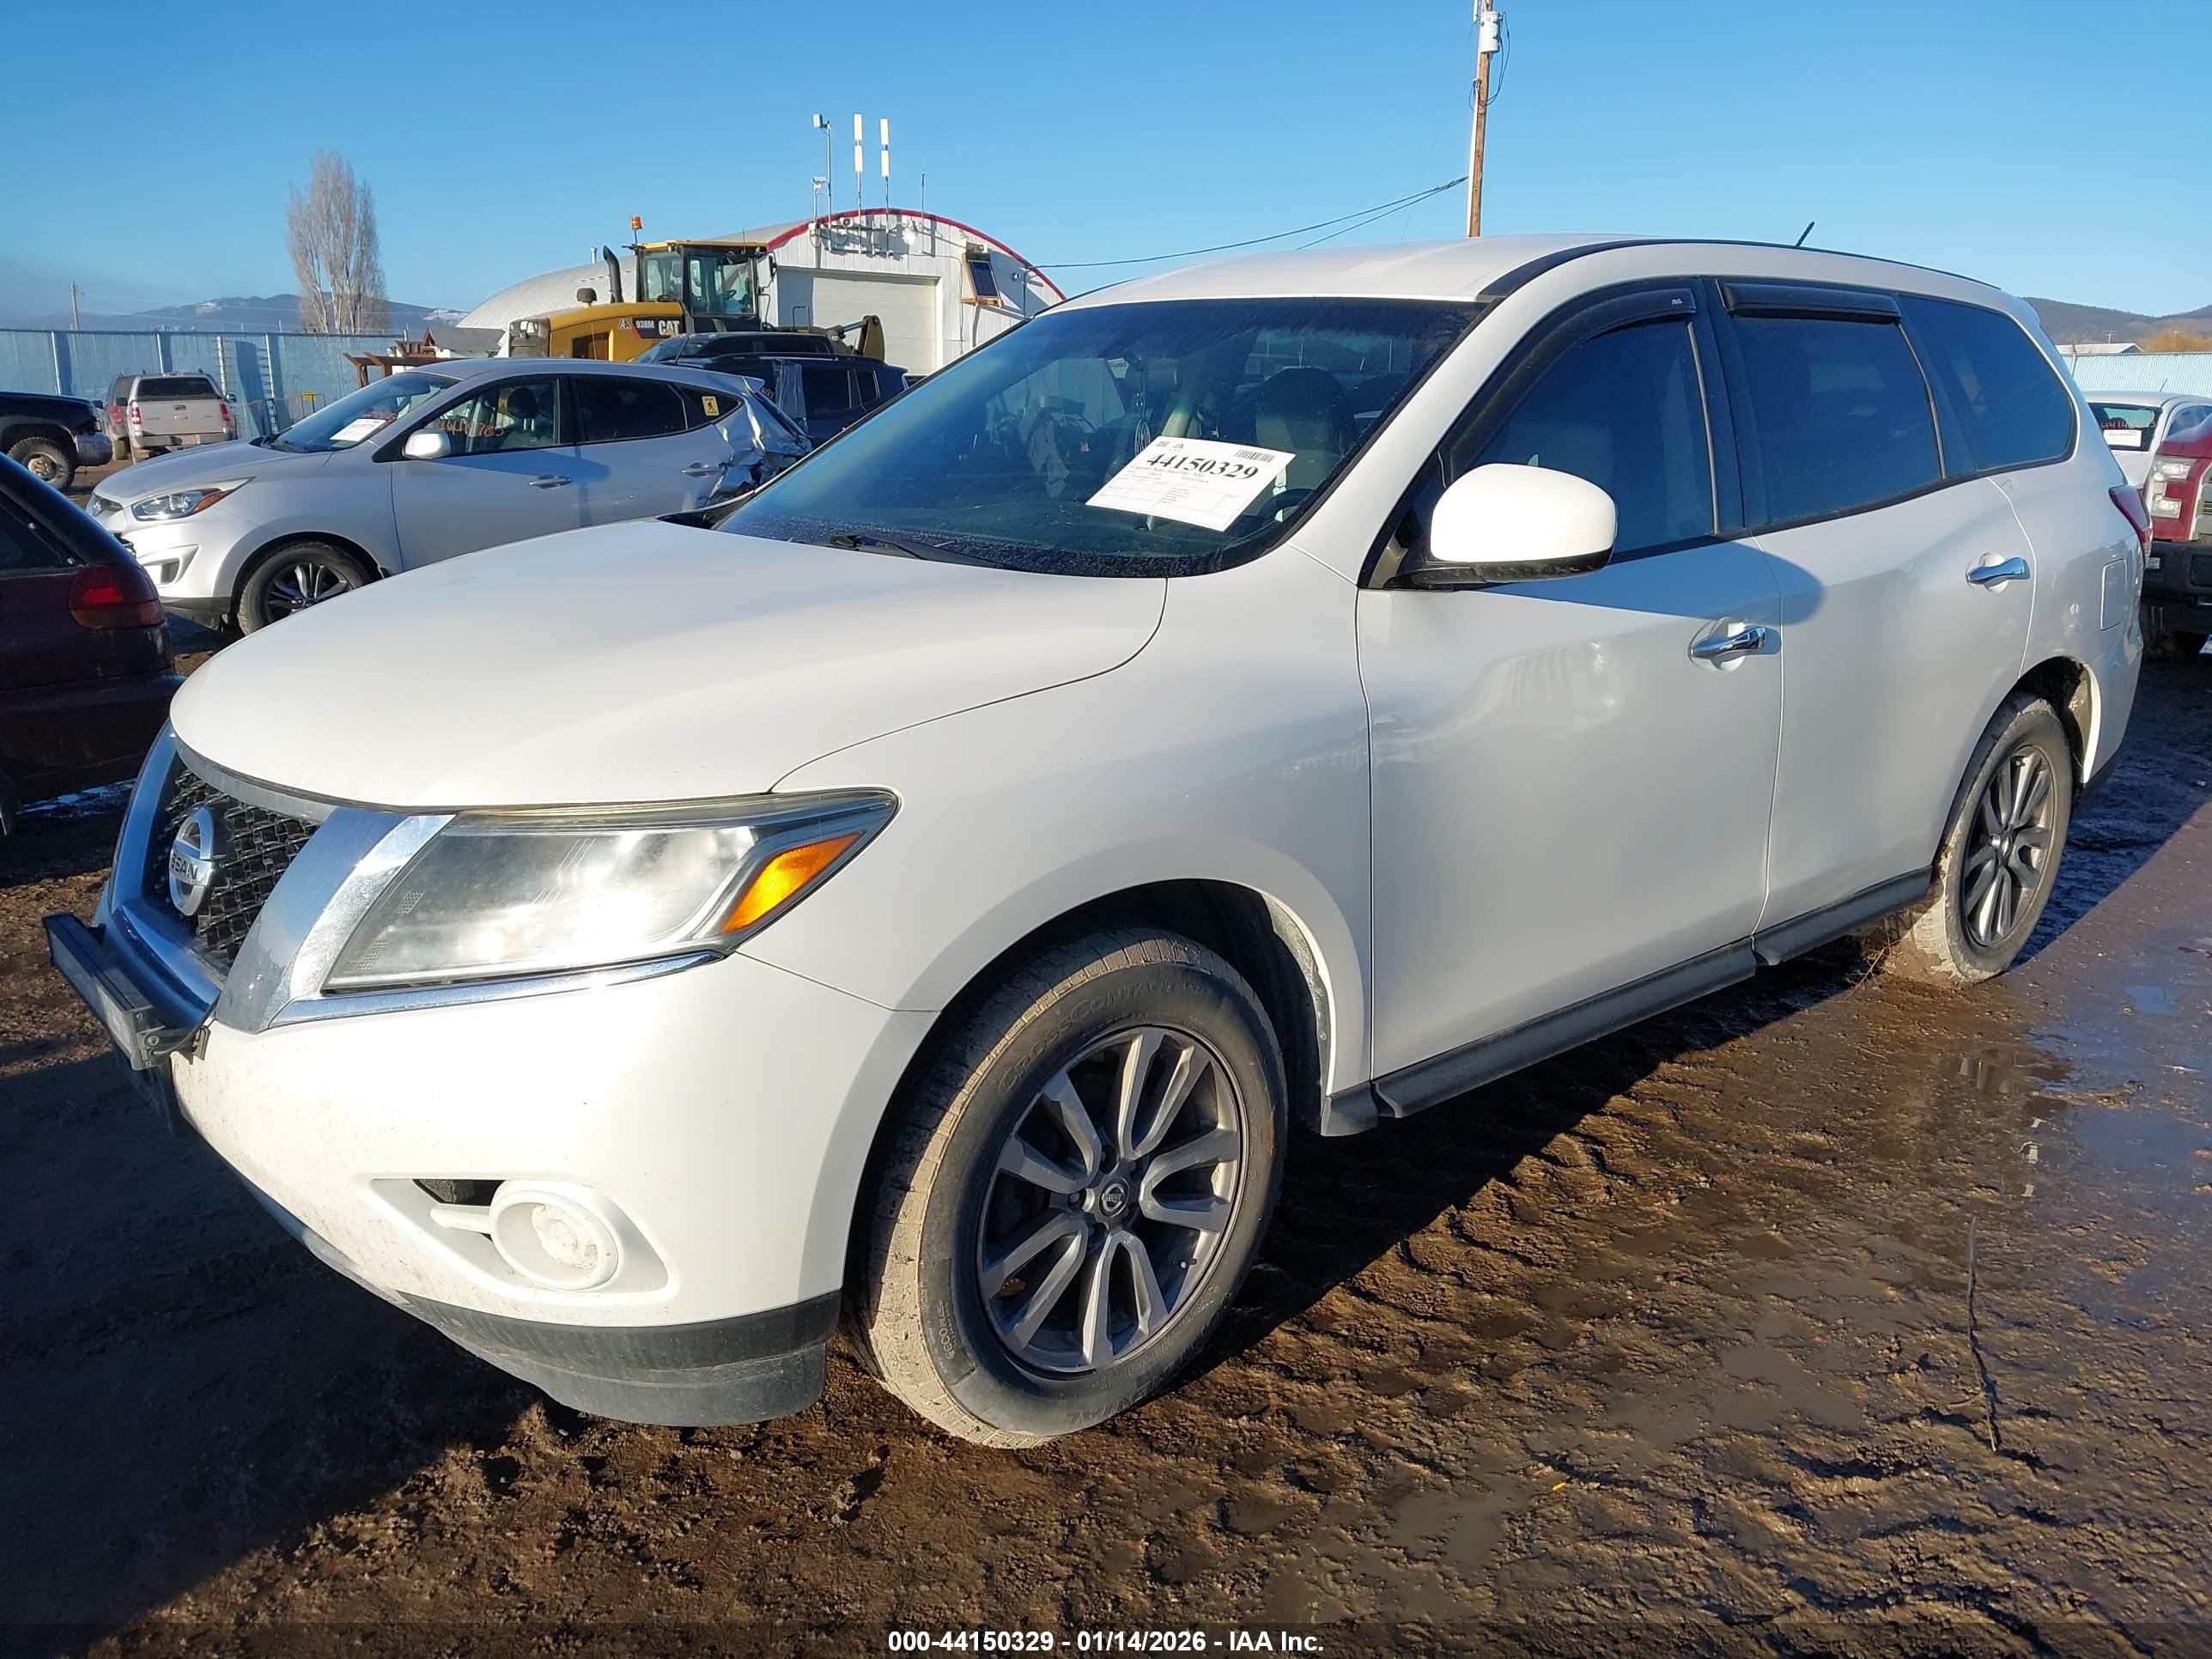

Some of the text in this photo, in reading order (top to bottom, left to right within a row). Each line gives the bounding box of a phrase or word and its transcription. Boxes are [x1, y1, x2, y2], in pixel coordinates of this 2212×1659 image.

[635, 319, 680, 336] 938M CAT
[1146, 453, 1259, 480] 44150329
